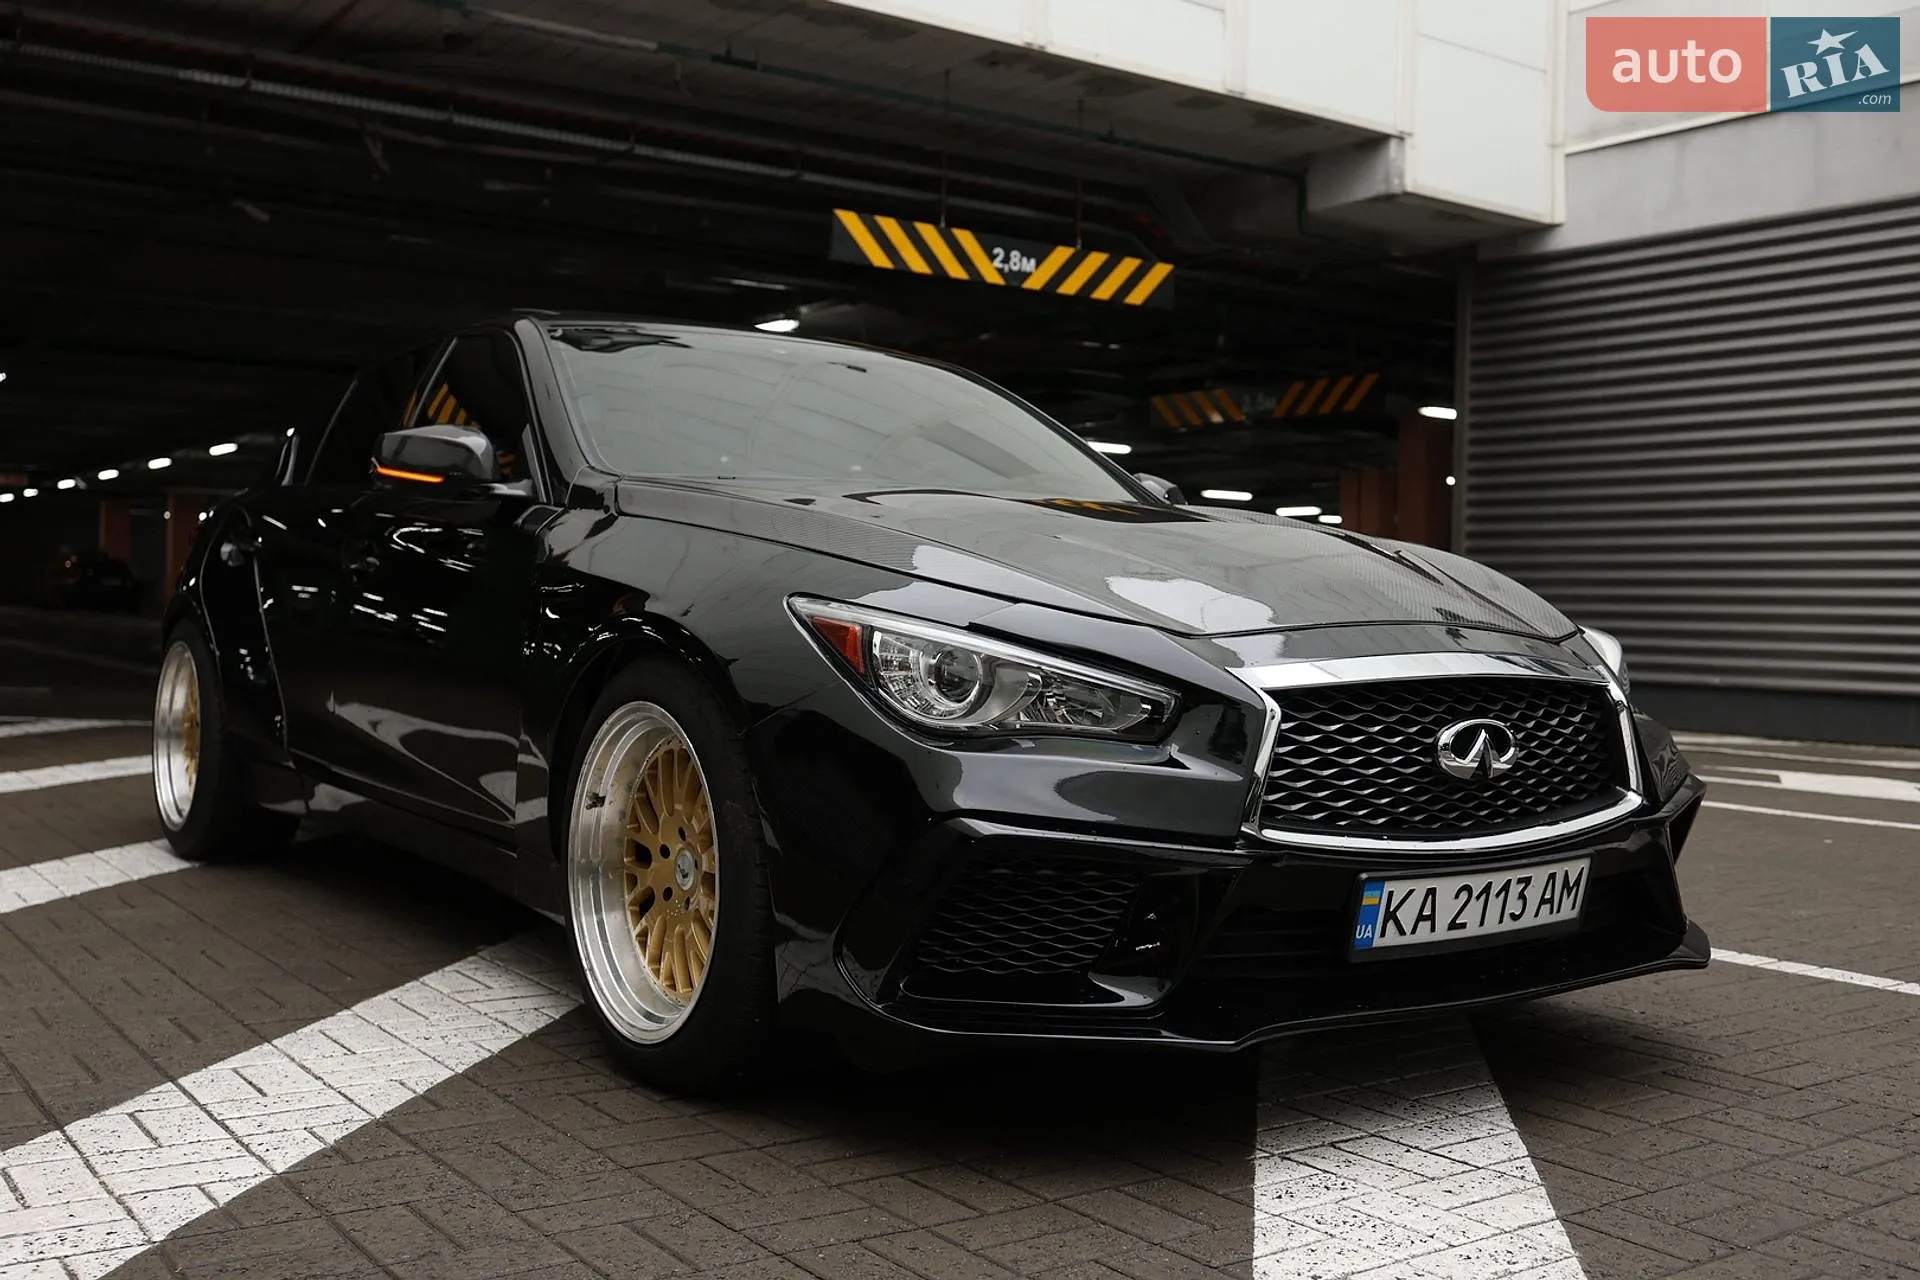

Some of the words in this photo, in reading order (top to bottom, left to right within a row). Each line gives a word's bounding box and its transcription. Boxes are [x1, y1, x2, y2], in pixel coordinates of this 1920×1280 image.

[1379, 886, 1437, 938] KA
[1447, 875, 1533, 931] 2113
[1533, 865, 1585, 919] AM
[1355, 924, 1373, 939] UA
